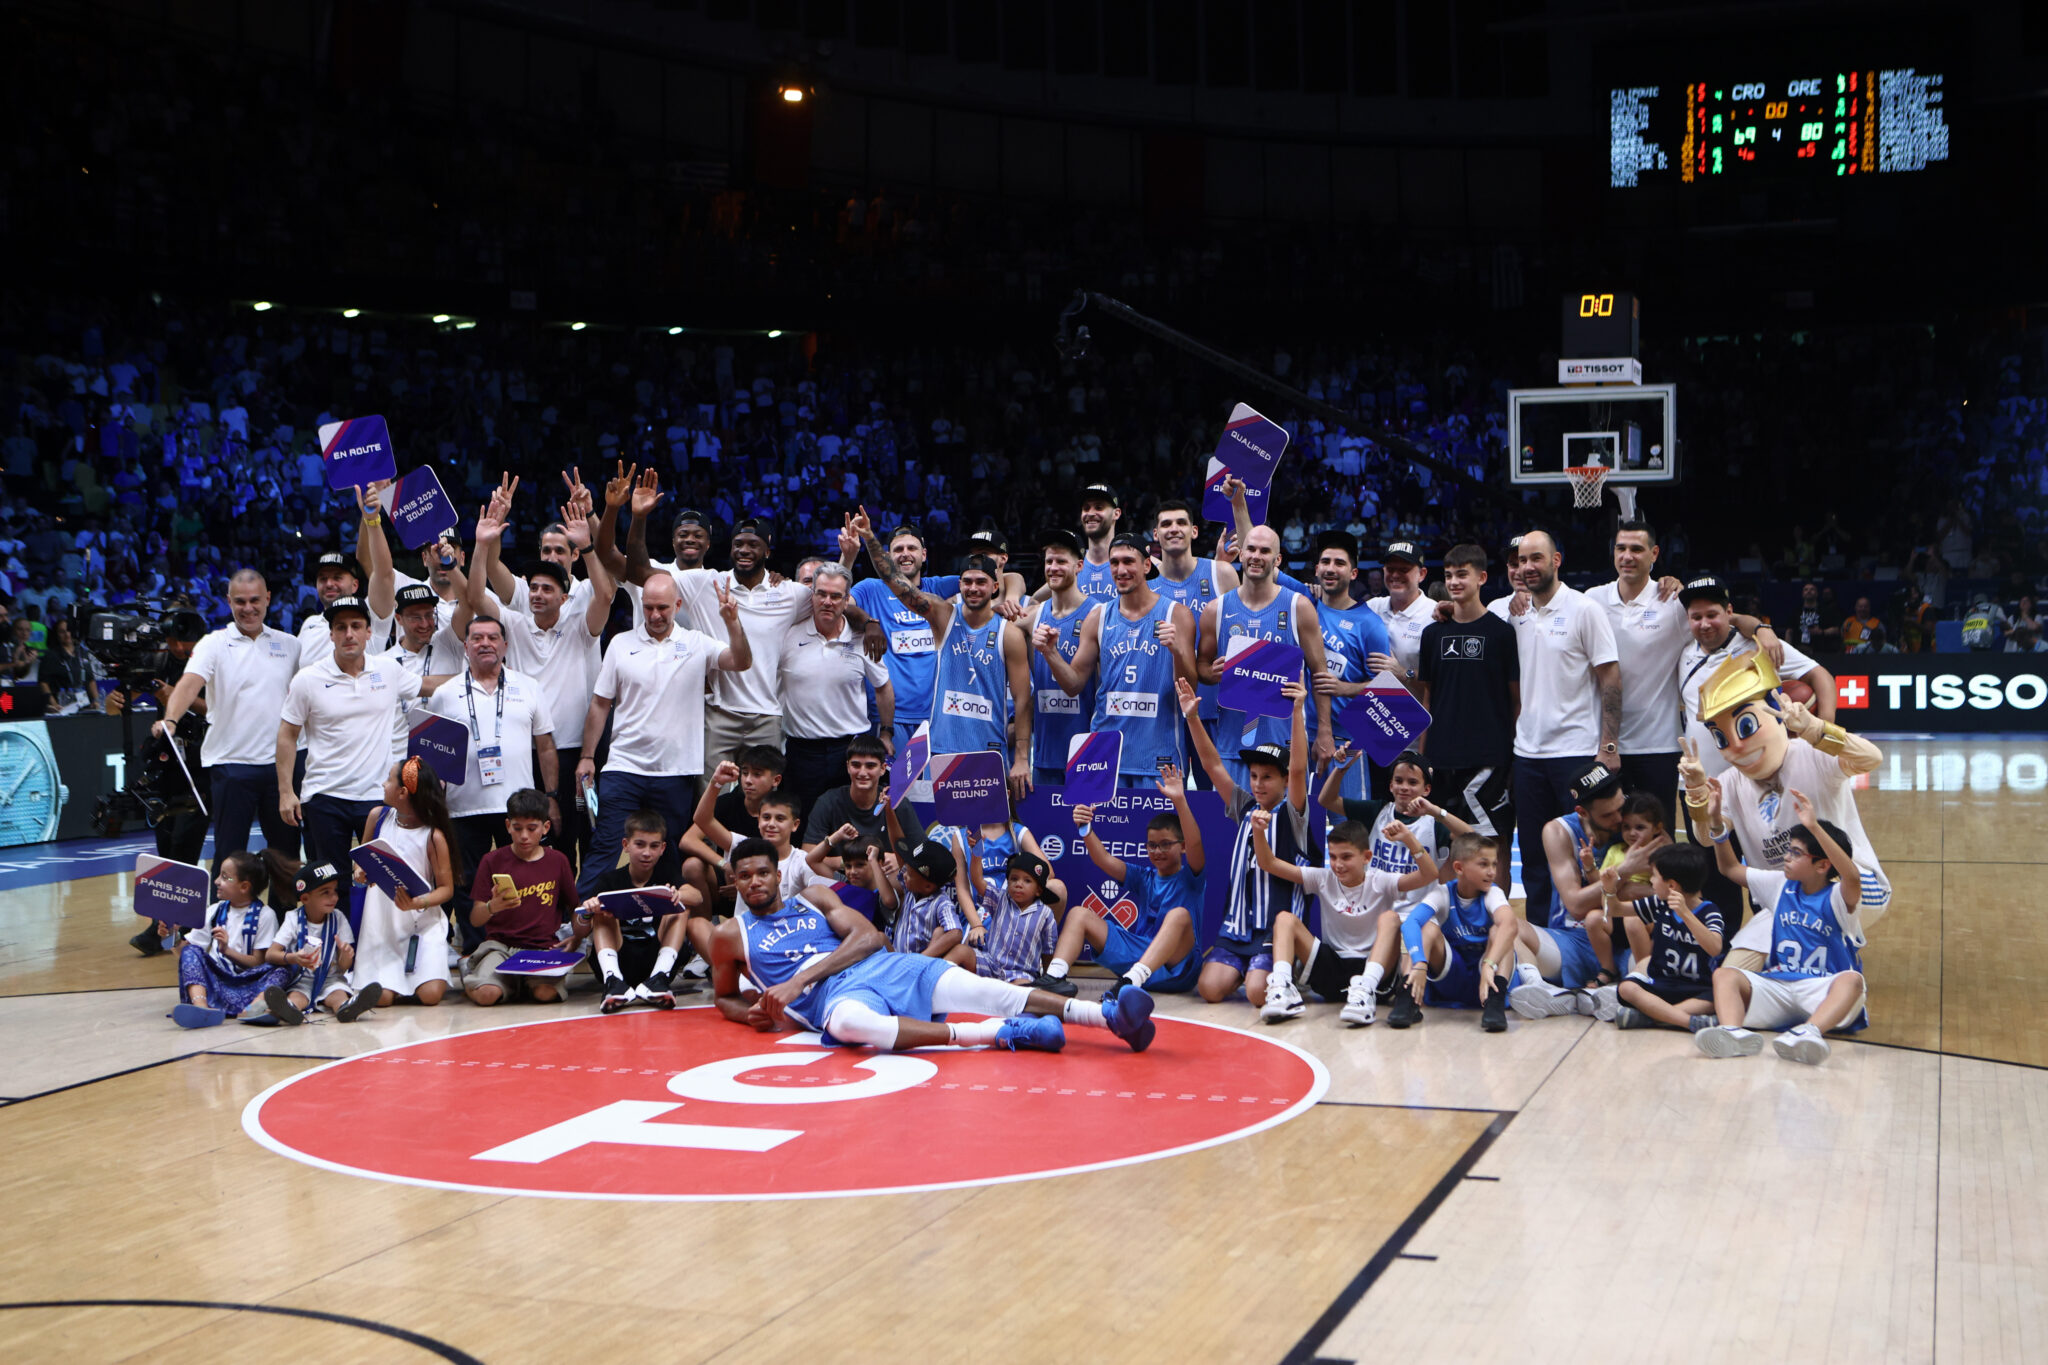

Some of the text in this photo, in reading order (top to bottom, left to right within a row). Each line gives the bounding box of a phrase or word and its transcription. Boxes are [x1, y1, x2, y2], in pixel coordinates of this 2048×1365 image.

[1731, 82, 1766, 101] CRO
[1734, 126, 1756, 145] 69
[1772, 128, 1781, 142] 4
[1801, 122, 1823, 141] 80
[1584, 364, 1624, 373] TISSOT
[333, 443, 382, 460] EN ROUTE
[1230, 430, 1272, 462] QUALIFIED
[393, 488, 438, 520] PARIS 2024
[406, 502, 434, 522] BOUND
[1081, 583, 1119, 599] ELLAS
[1183, 599, 1208, 613] LAS
[894, 610, 928, 623] HELL
[952, 641, 993, 665] HELLAS
[1056, 640, 1078, 657] LAS
[1109, 638, 1158, 659] HELLAS
[968, 667, 976, 685] 7
[1125, 665, 1137, 683] 5
[1234, 667, 1288, 684] EN ROUTE
[1877, 674, 2048, 710] TISSO
[1365, 691, 1410, 739] PARIS 2024
[1366, 707, 1394, 737] BOUND
[420, 738, 432, 747] ET
[1076, 763, 1087, 772] ET
[938, 778, 1000, 790] PARIS 2024
[952, 790, 988, 799] BOUND
[1051, 793, 1175, 811] BING PASS
[1094, 814, 1106, 823] ET
[1072, 839, 1149, 858] GECE
[370, 852, 383, 864] EN
[982, 856, 1008, 868] ELLA
[140, 877, 201, 898] PARIS 2024
[152, 889, 188, 904] BOUND
[517, 880, 556, 898] moge
[1780, 911, 1832, 937] HELLAS
[758, 918, 817, 951] HELLAS
[1664, 949, 1700, 981] 34
[1777, 940, 1828, 975] 34
